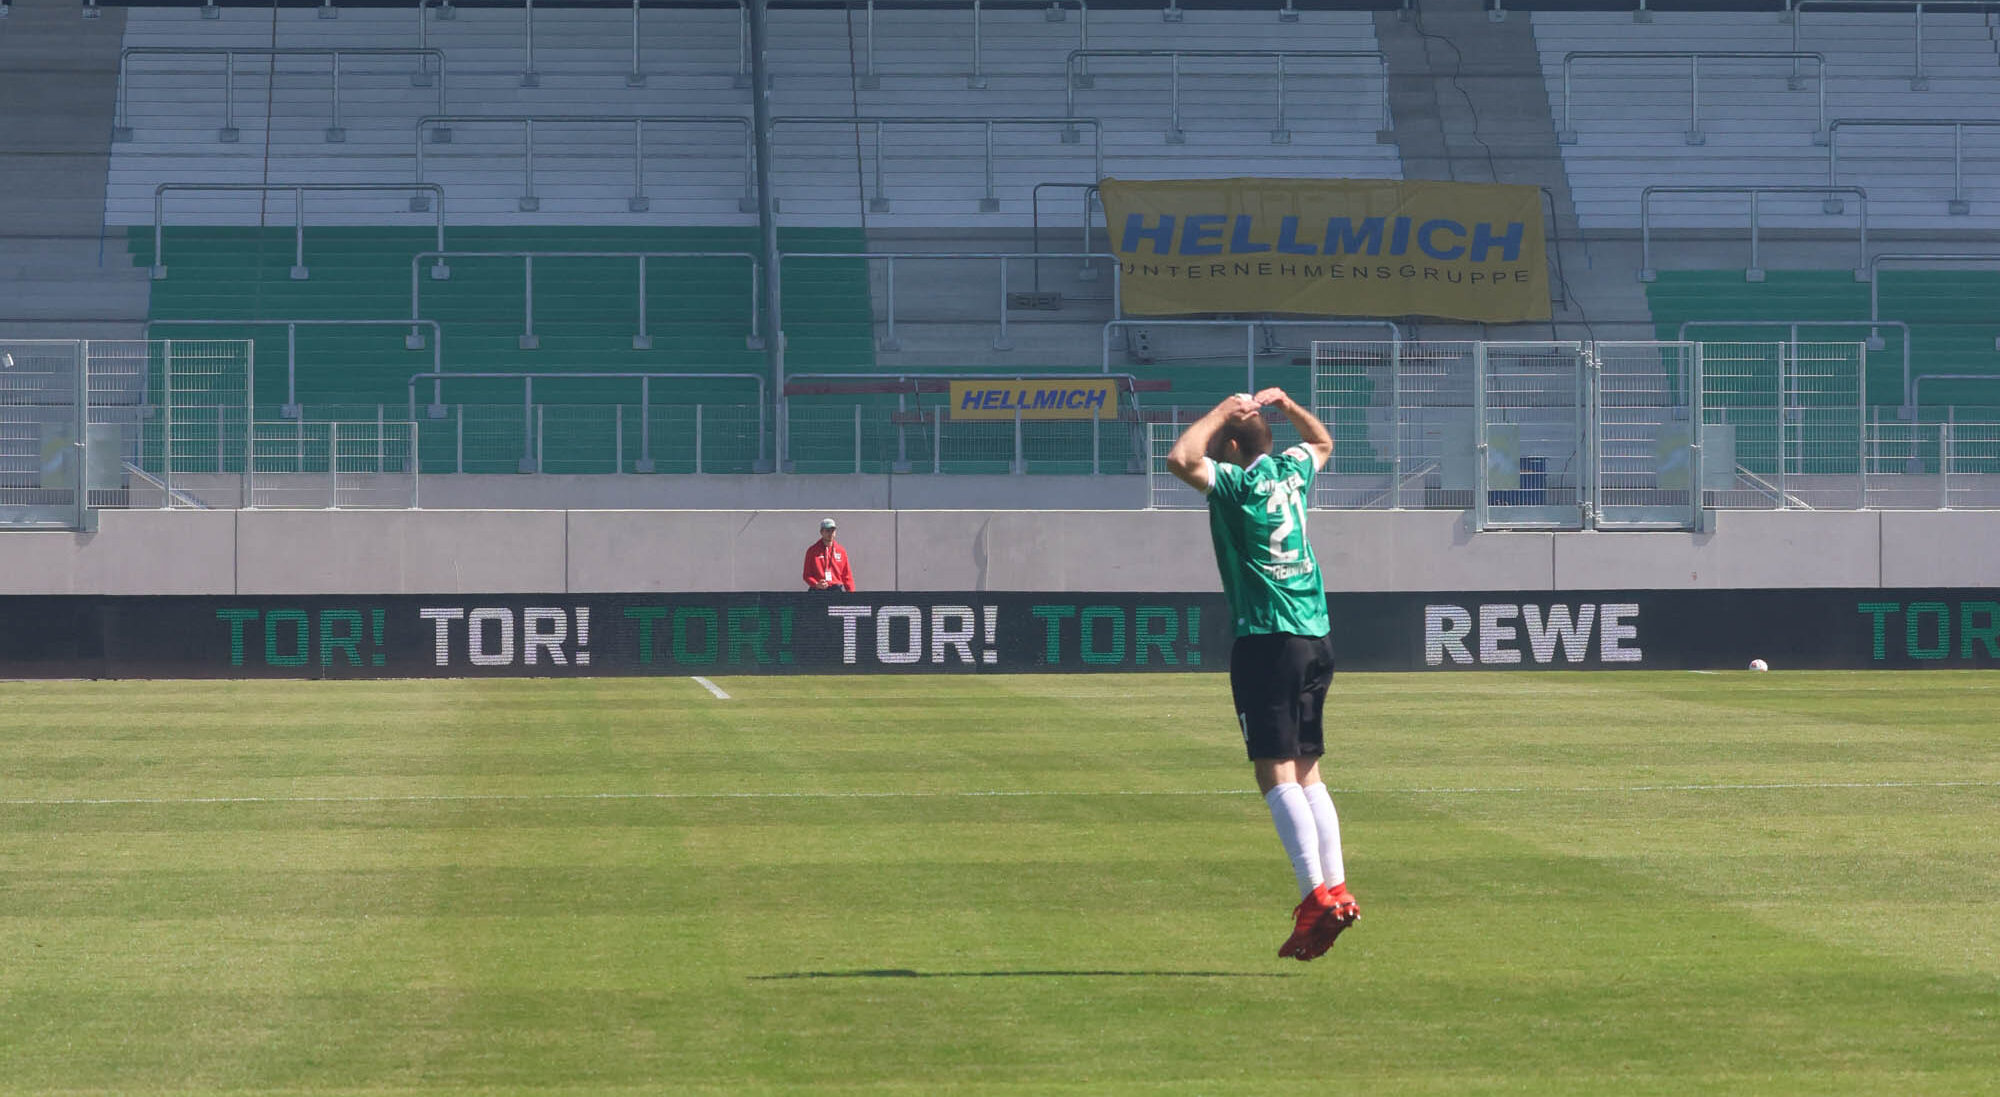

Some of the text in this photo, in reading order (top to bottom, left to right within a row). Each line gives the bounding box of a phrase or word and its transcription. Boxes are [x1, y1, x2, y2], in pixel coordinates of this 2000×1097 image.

[1120, 213, 1525, 262] HELLMICH
[1119, 262, 1529, 285] UNTERNEHMENSGRUPPE
[960, 389, 1107, 410] HELLMICH
[1266, 489, 1308, 563] 21
[215, 605, 1201, 667] TOR! TOR! TOR! TOR! TOR!
[1424, 603, 1643, 666] REWE
[1857, 602, 2000, 660] TOR
